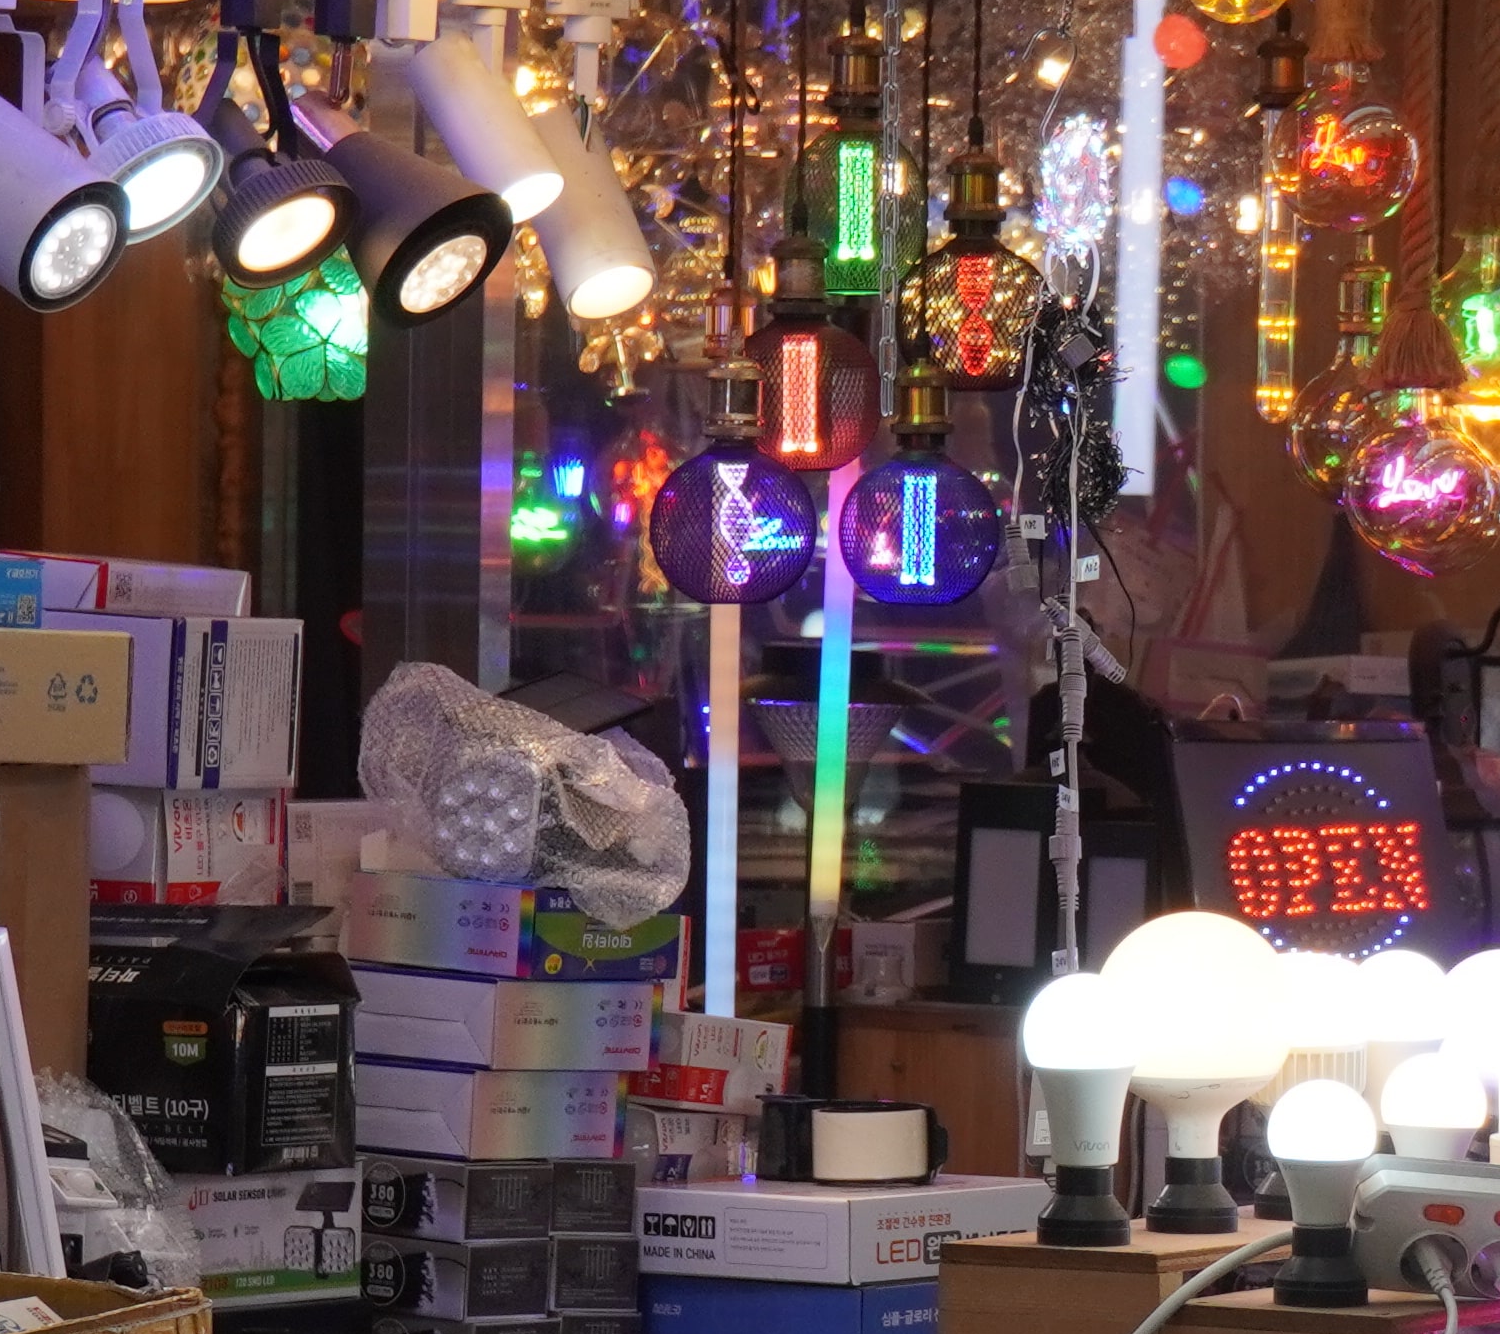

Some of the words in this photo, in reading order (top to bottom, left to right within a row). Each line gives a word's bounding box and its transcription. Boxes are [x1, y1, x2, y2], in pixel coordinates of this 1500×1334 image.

[1227, 821, 1429, 918] OPEN
[171, 1042, 199, 1058] 10M
[165, 1098, 210, 1121] (10구)
[212, 1191, 237, 1203] SOLAR
[238, 1189, 266, 1200] SENSOR
[643, 1245, 672, 1258] MADE
[673, 1247, 683, 1259] IN
[685, 1247, 716, 1261] CHINA
[876, 1238, 921, 1265] LED
